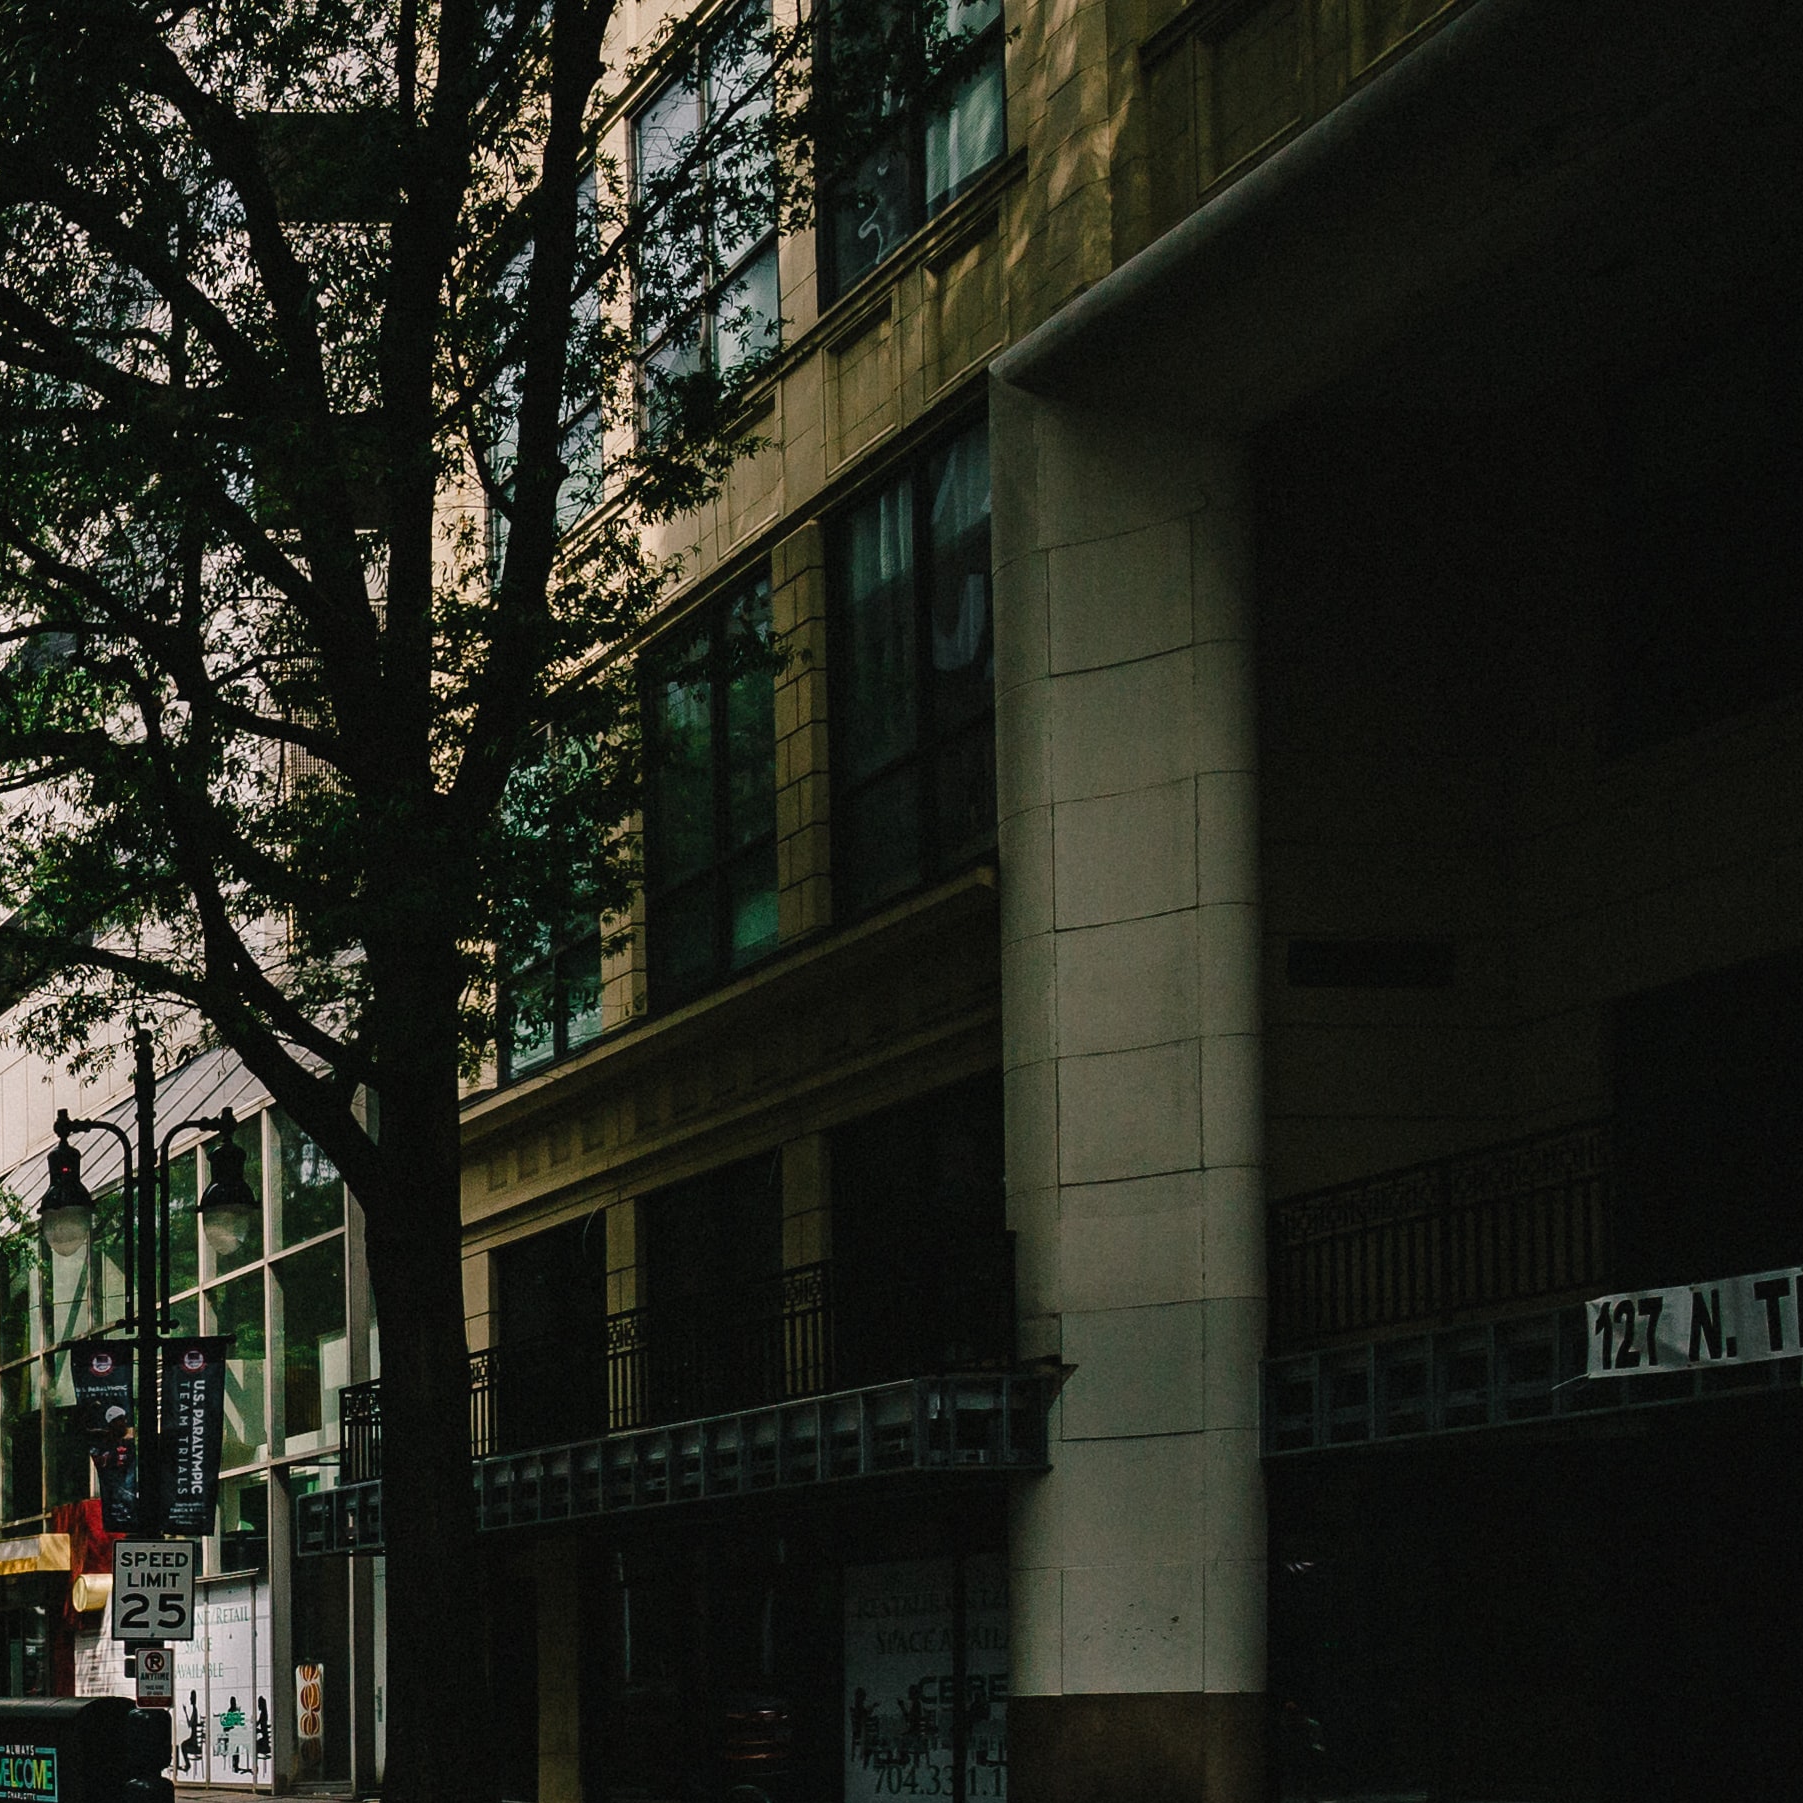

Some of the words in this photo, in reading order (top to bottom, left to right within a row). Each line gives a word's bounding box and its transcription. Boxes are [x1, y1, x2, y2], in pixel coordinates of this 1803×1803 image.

[1594, 1296, 1663, 1370] 127
[1688, 1288, 1737, 1361] N.
[1753, 1276, 1803, 1352] T
[179, 1381, 190, 1426] TEAM
[193, 1380, 206, 1406] U.S.
[177, 1437, 188, 1495] TRIALS
[191, 1409, 205, 1495] PARALYMPIC
[120, 1551, 189, 1568] SPEED
[127, 1572, 180, 1588] LIMIT
[119, 1593, 186, 1629] 25
[5, 1744, 35, 1756] ALWAYS
